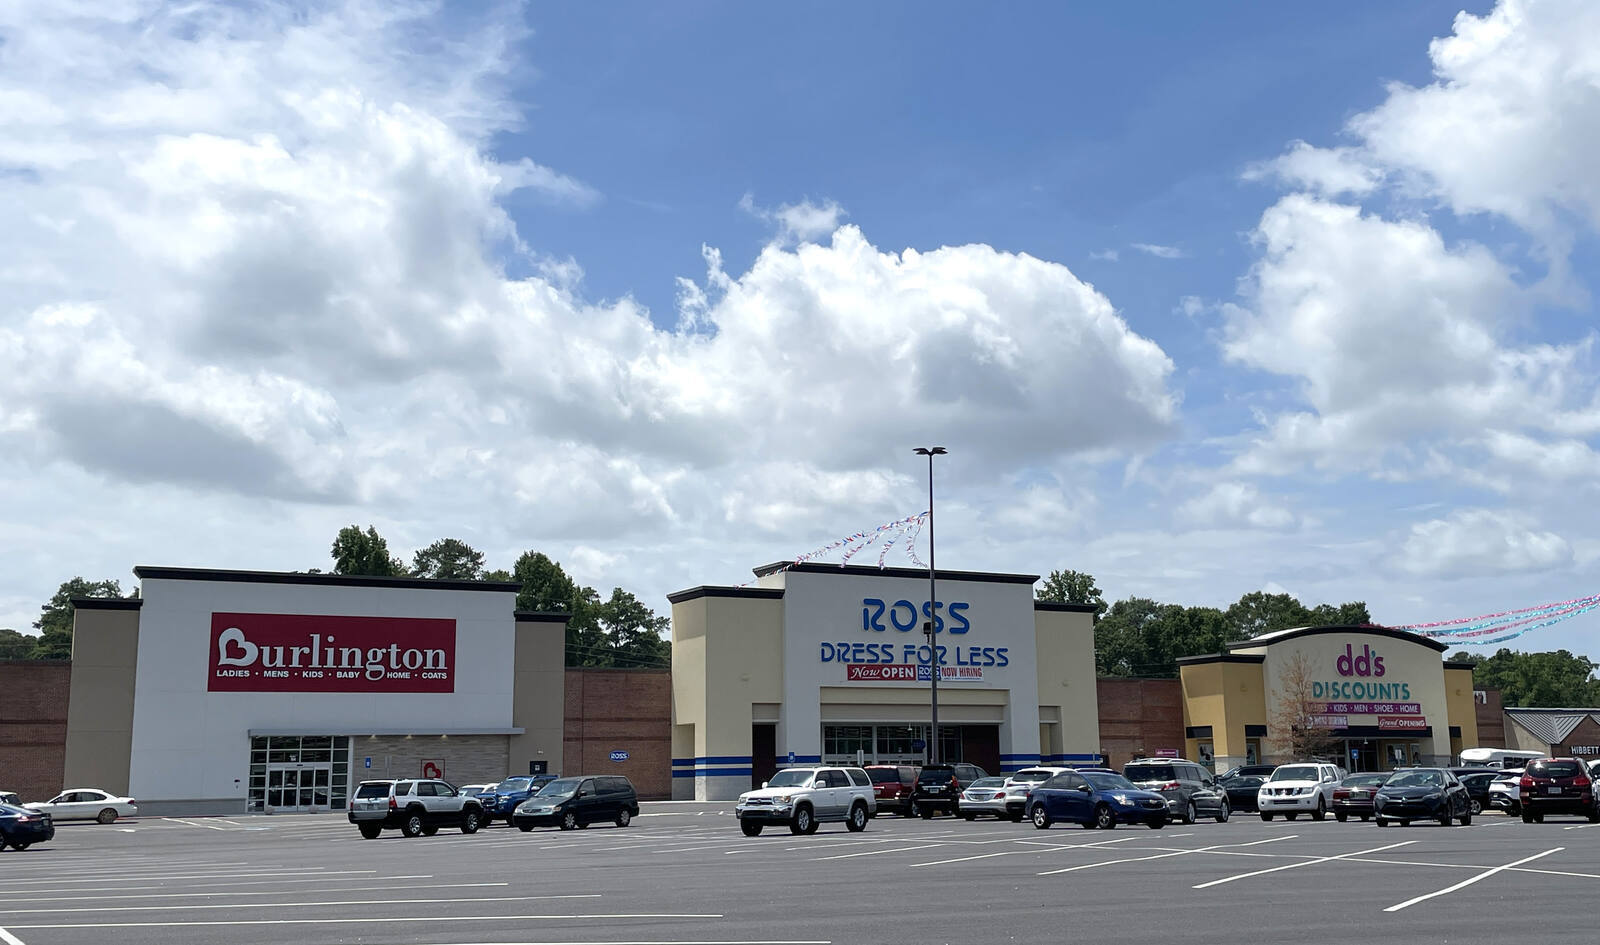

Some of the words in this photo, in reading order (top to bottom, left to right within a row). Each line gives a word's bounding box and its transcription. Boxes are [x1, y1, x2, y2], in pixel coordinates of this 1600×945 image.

[863, 598, 970, 635] ROSS
[218, 627, 448, 681] Burlington
[821, 642, 895, 664] DRESS
[903, 645, 948, 665] FOR
[956, 646, 1009, 667] LESS
[1336, 643, 1386, 677] dd's
[216, 669, 250, 677] LADIES
[263, 670, 289, 678] MENS
[302, 670, 324, 678] KIDS
[336, 671, 360, 679] BABY
[387, 671, 411, 679] HOME
[850, 666, 881, 679] Now
[881, 667, 914, 678] OPEN
[918, 667, 940, 675] ROS
[941, 667, 958, 677] NOW
[959, 667, 983, 677] HIRING
[1312, 681, 1411, 700] DISCOUNTS
[1333, 704, 1348, 712] KIDS
[1353, 704, 1368, 712] MEN
[1374, 704, 1394, 712] SHOES
[1399, 704, 1418, 713] HOME
[1399, 719, 1425, 727] OPENING
[1571, 746, 1600, 755] HIBBETT
